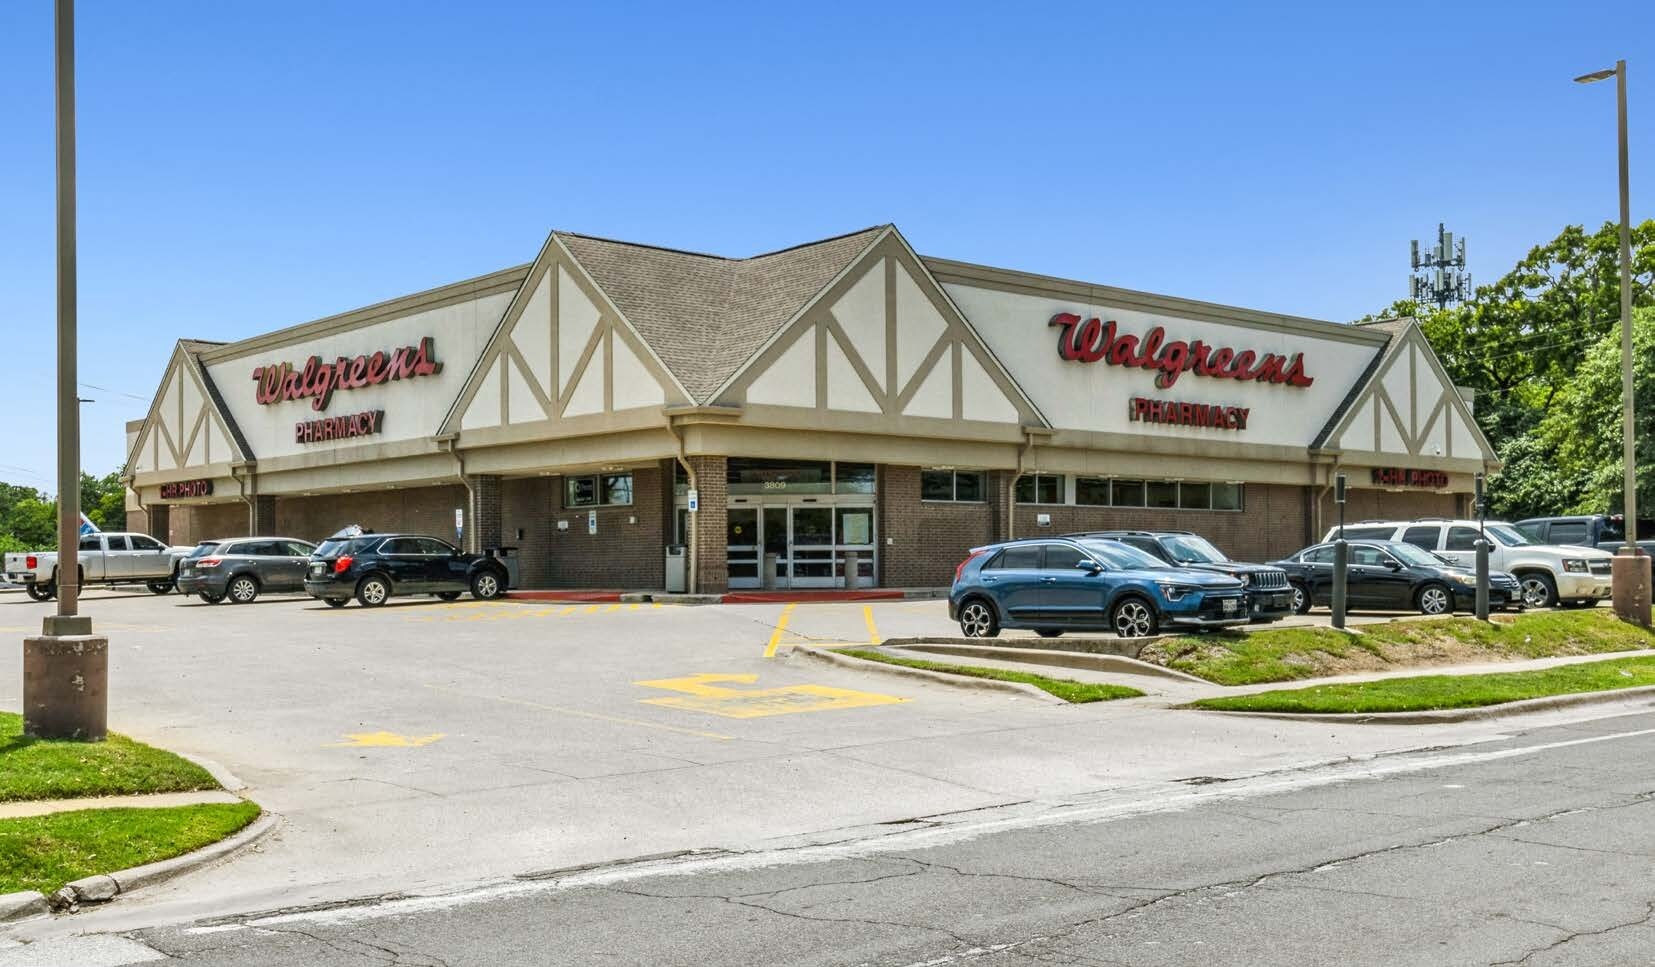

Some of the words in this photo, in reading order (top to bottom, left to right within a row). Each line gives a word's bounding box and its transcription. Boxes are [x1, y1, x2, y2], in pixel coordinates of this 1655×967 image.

[1048, 312, 1314, 389] Walgreens
[253, 337, 441, 411] Walgreens
[296, 410, 383, 443] PHARMACY
[1129, 398, 1250, 430] PHARMACY
[179, 480, 208, 497] PHOTO
[763, 481, 786, 489] 3809
